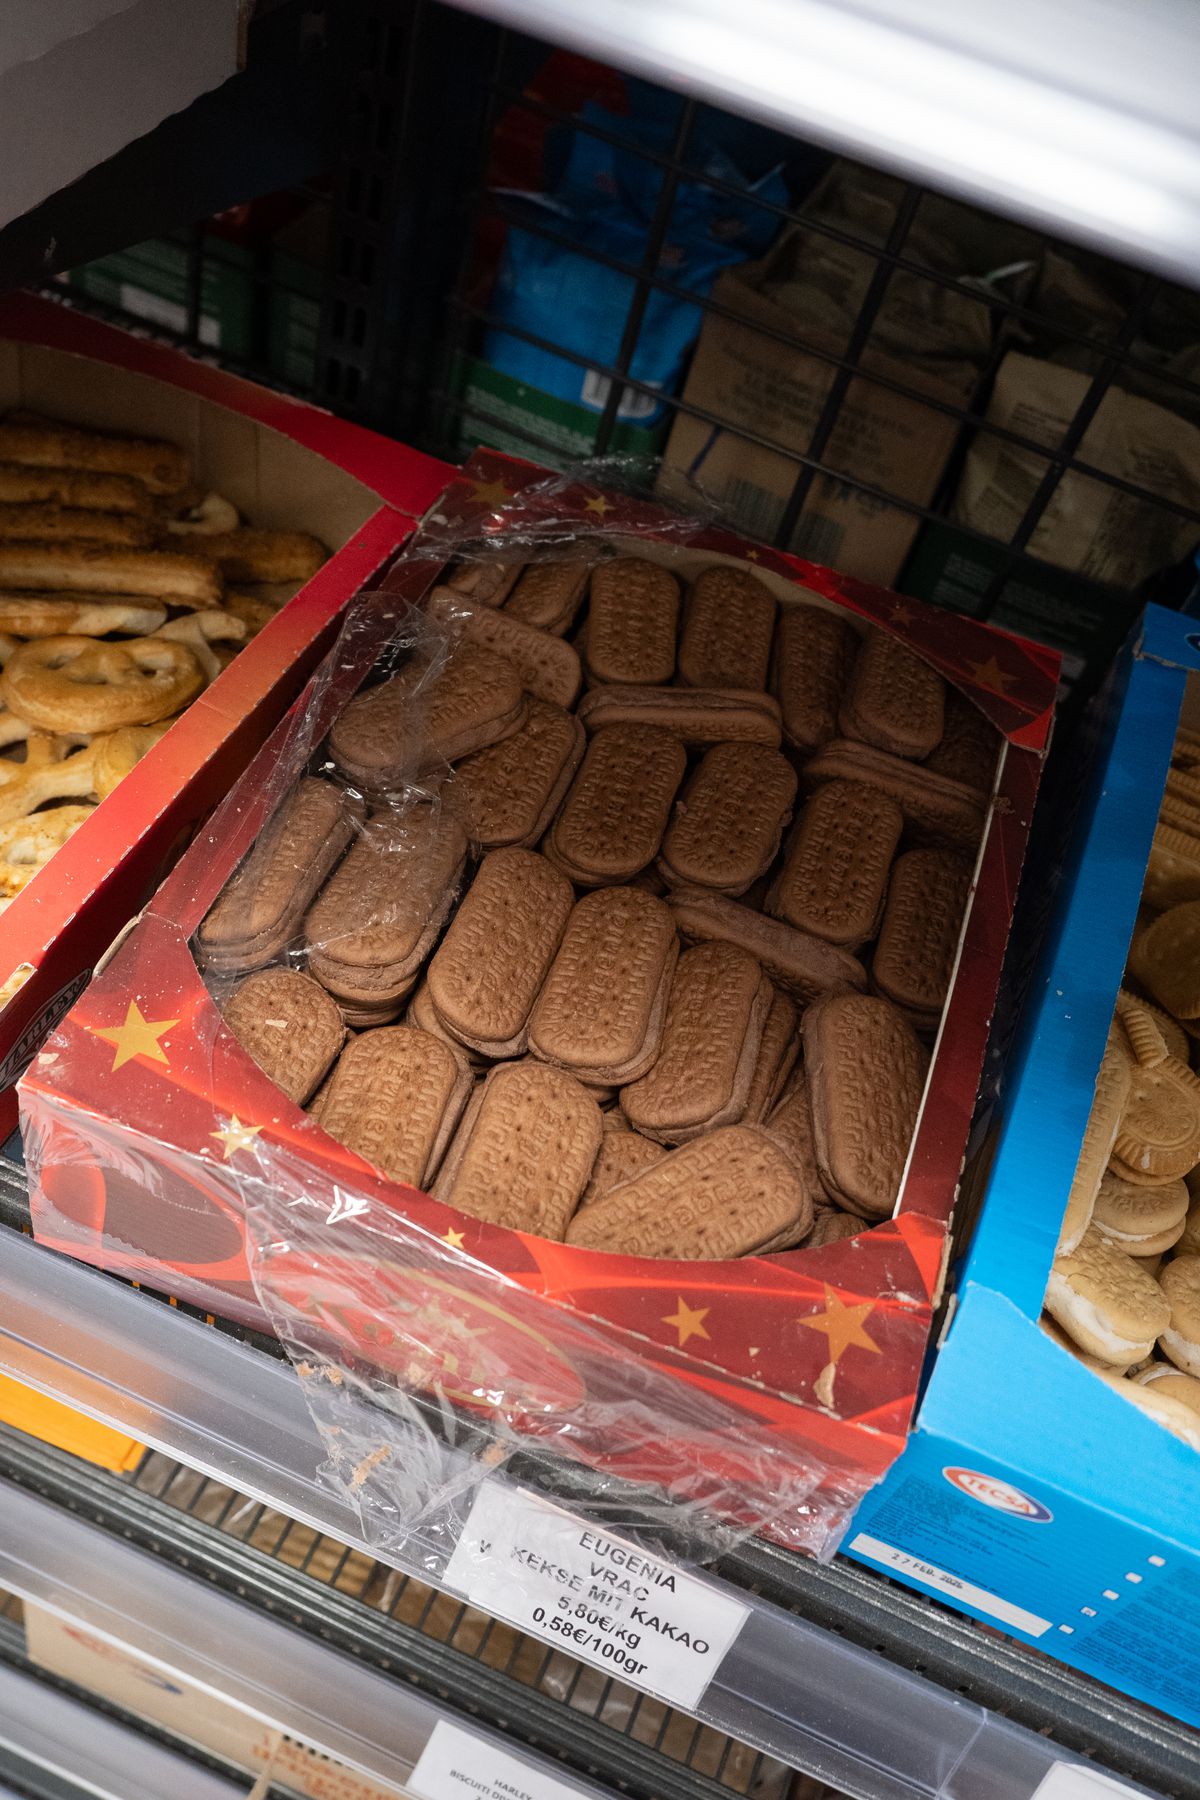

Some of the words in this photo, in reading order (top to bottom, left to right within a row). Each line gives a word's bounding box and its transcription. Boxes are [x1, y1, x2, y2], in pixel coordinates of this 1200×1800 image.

[578, 1531, 678, 1593] EUGENIA
[589, 1562, 650, 1602] VRAC
[510, 1545, 583, 1593] KEKSE
[587, 1584, 624, 1611] MIT
[629, 1606, 710, 1655] KAKAO
[557, 1595, 642, 1649] 5,80€/kg
[532, 1607, 648, 1677] 0,58€/100gr
[449, 1769, 490, 1795] BISCUITI
